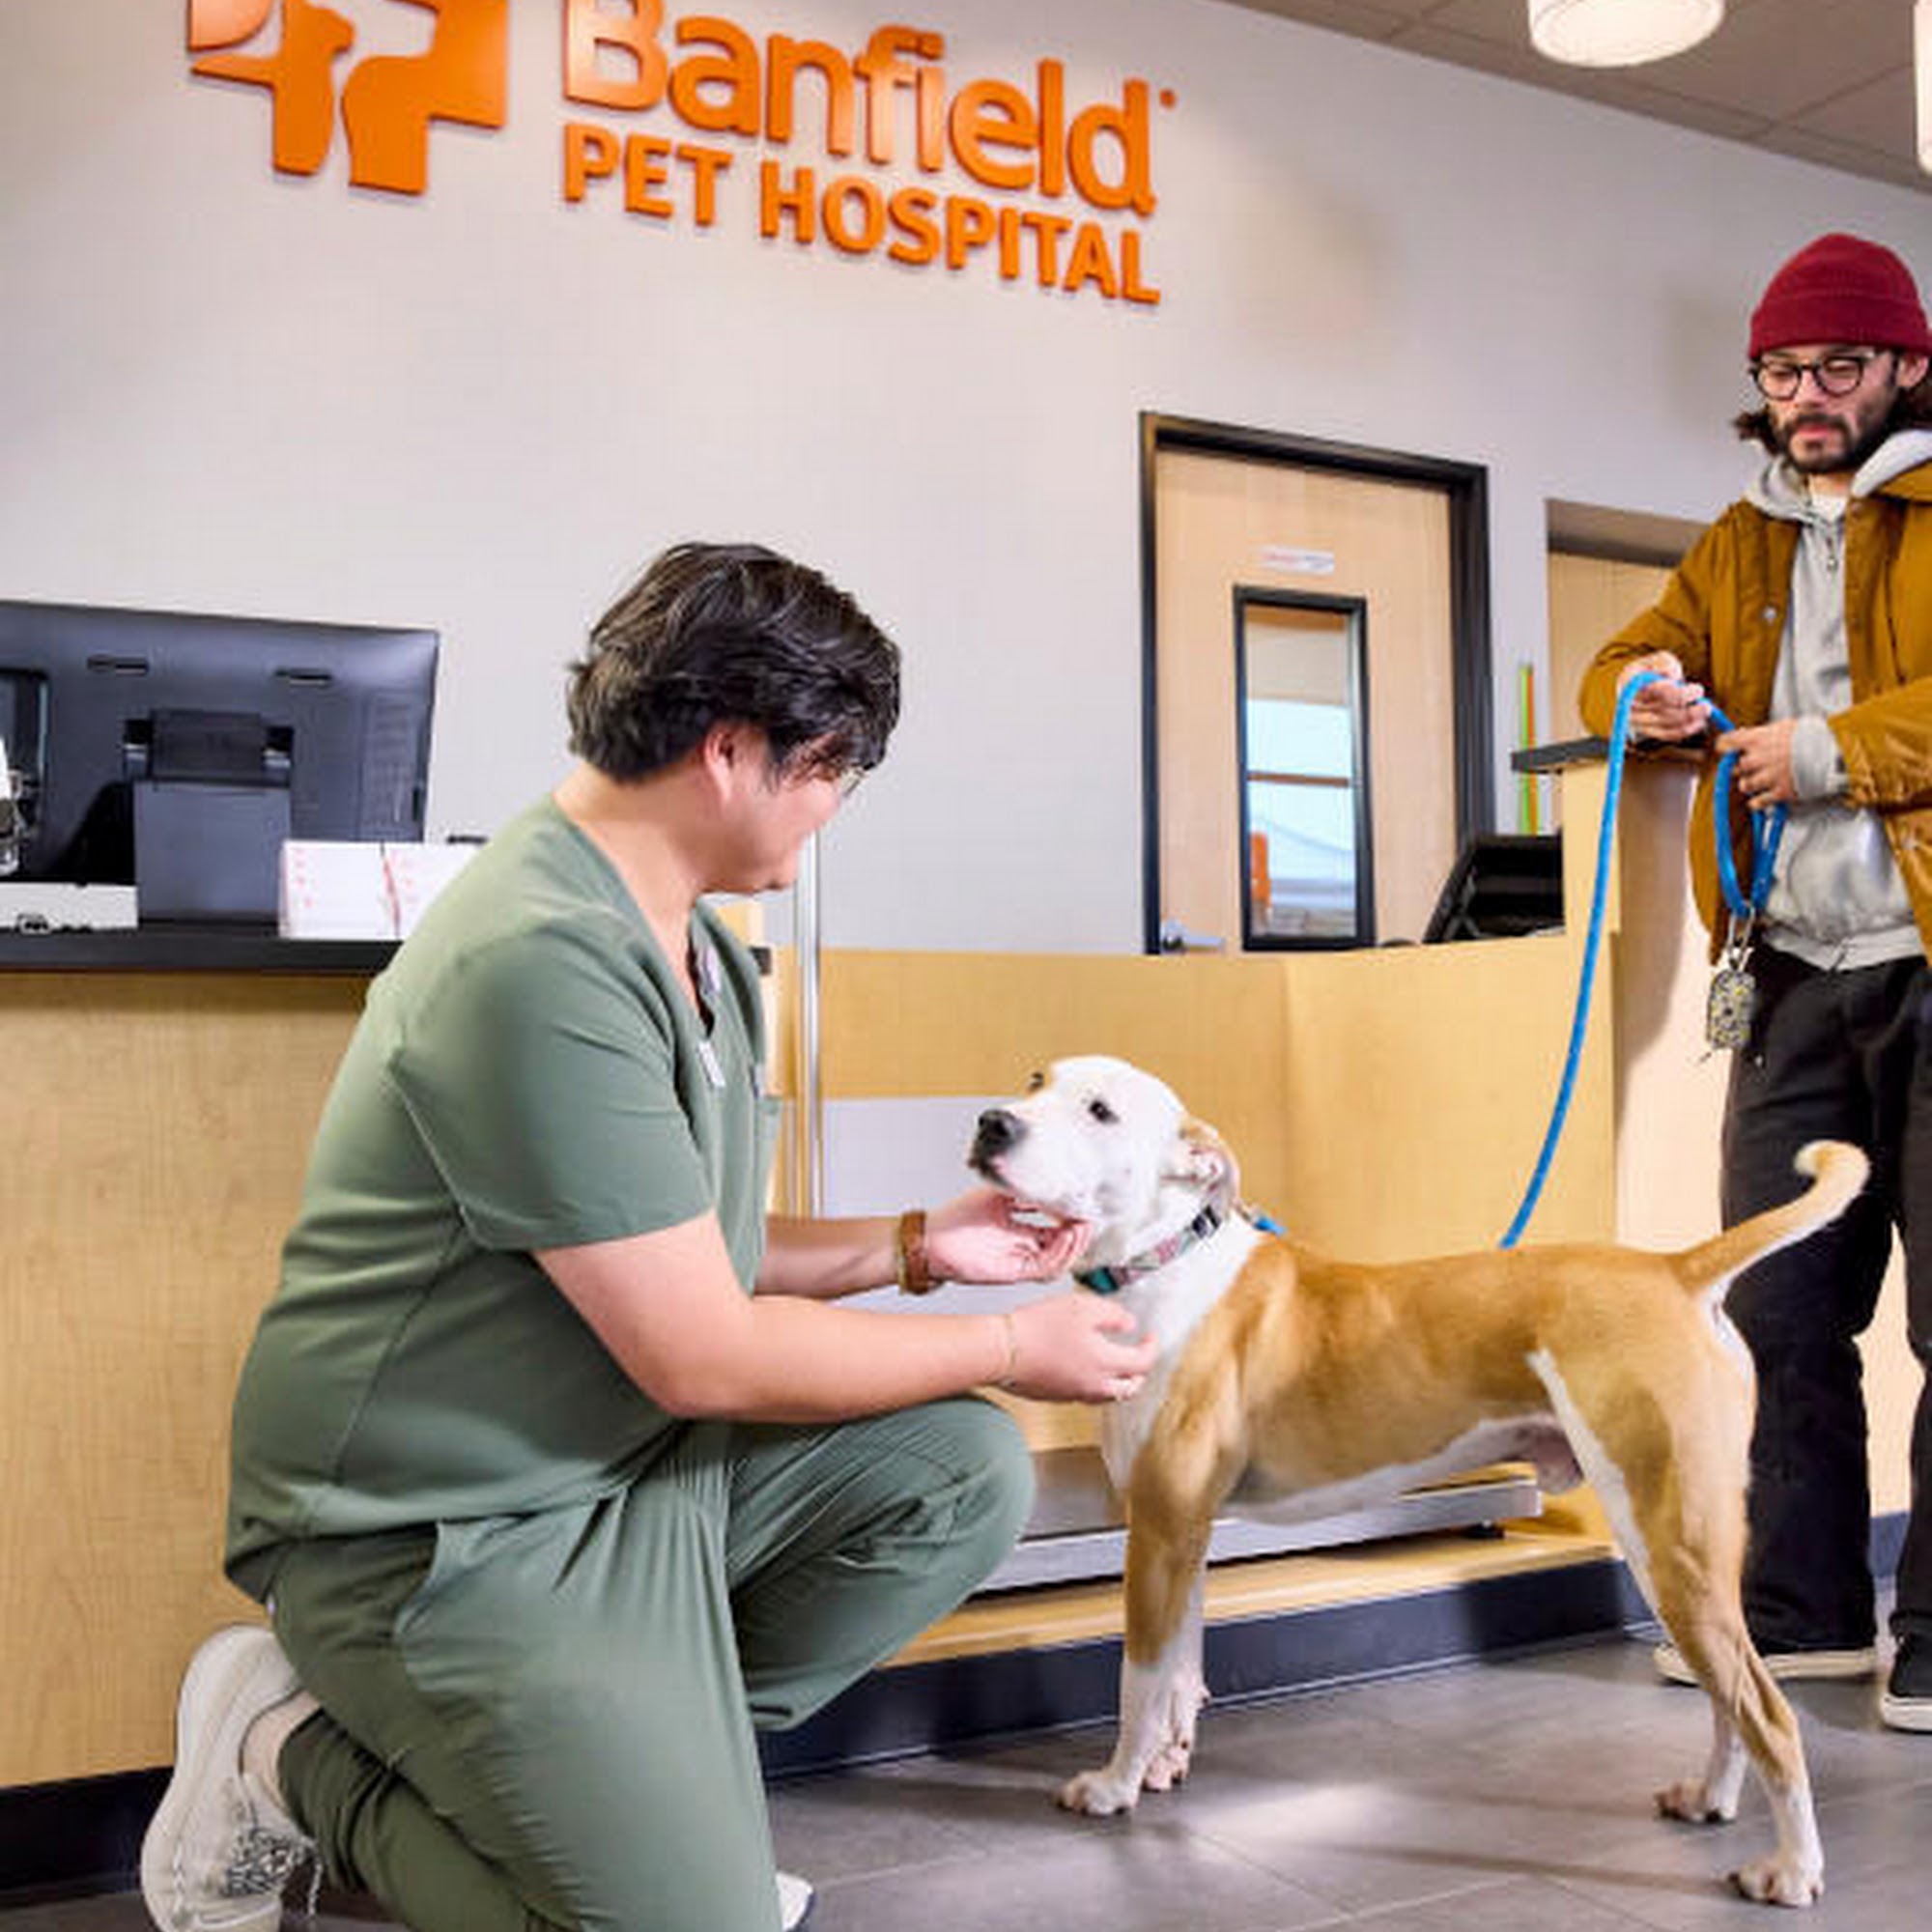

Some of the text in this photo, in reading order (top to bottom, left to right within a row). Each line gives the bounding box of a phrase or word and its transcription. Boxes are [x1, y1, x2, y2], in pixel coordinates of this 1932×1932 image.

[562, 0, 1157, 217] Banfield
[563, 124, 1160, 304] PET HOSPITAL
